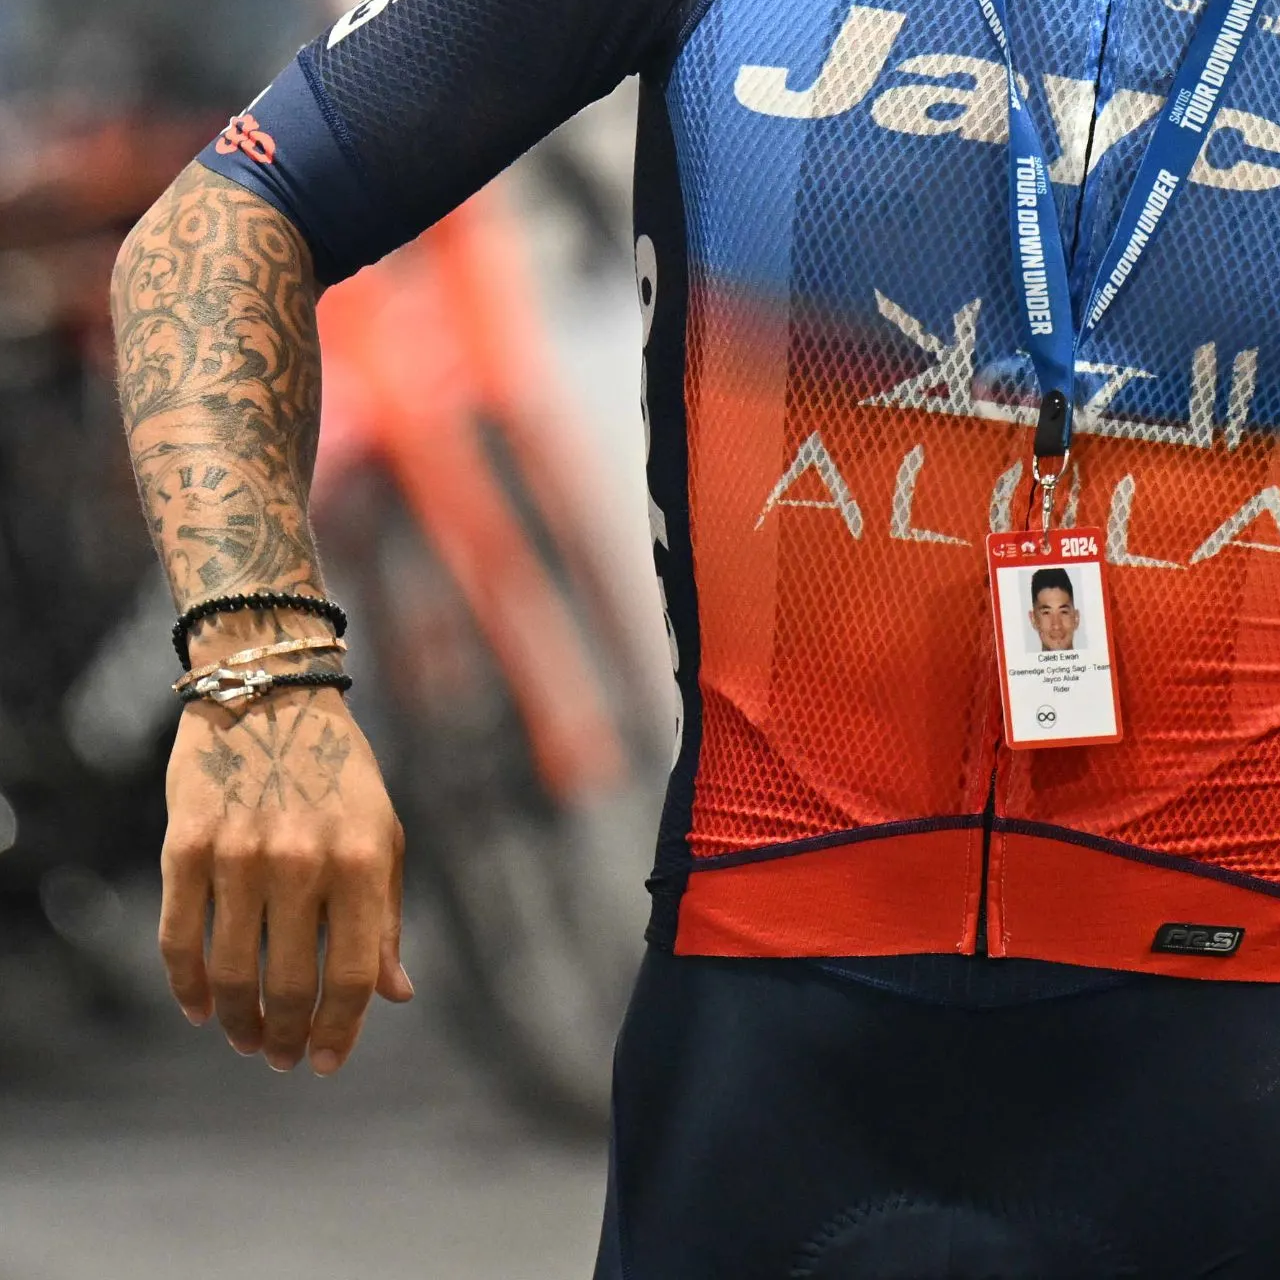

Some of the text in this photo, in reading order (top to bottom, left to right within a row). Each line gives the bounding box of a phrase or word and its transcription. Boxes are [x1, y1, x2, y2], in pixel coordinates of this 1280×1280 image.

[1178, 83, 1220, 133] TOUR
[1199, 29, 1244, 88] DOWN
[1168, 88, 1192, 125] SANTOS
[1035, 156, 1047, 196] SANTOS
[1017, 155, 1053, 335] TOUR DOWN UNDER
[1085, 167, 1180, 329] TOUR DOWN UNDER
[1061, 537, 1098, 557] 2024
[1038, 654, 1058, 662] Caleb
